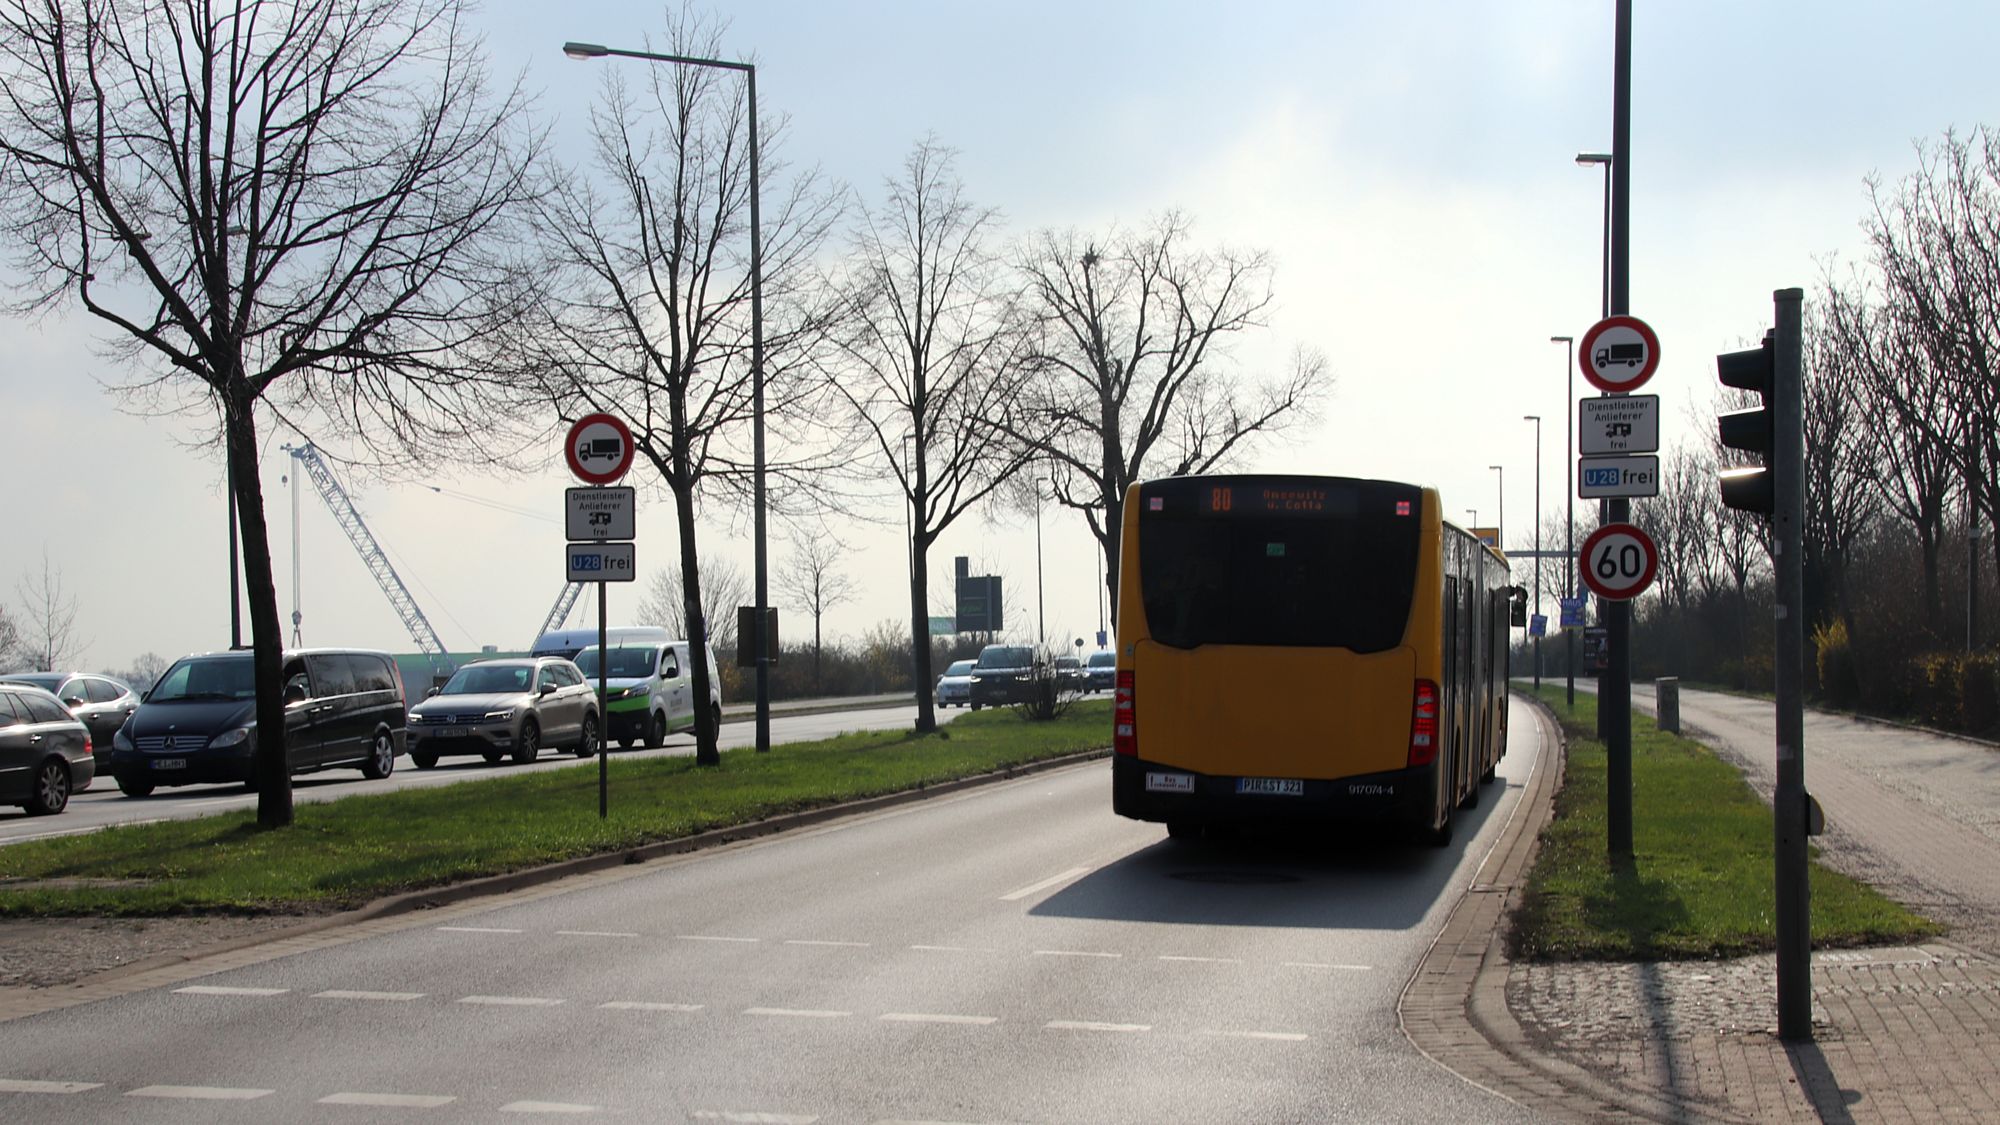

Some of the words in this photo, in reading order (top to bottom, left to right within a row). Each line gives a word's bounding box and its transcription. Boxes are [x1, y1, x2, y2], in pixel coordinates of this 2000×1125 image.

[1588, 401, 1648, 411] Dienstleister
[1595, 412, 1643, 421] Anlieferer
[1610, 440, 1627, 449] frei
[1586, 471, 1596, 484] U
[1600, 470, 1617, 484] 28
[1623, 468, 1653, 484] frei
[573, 492, 626, 500] Dienstleister
[1212, 487, 1232, 511] 80
[579, 502, 621, 510] Anlieferer
[593, 528, 608, 536] frei
[573, 556, 582, 569] U
[585, 556, 600, 569] 28
[604, 555, 630, 569] frei
[1597, 544, 1640, 579] 60
